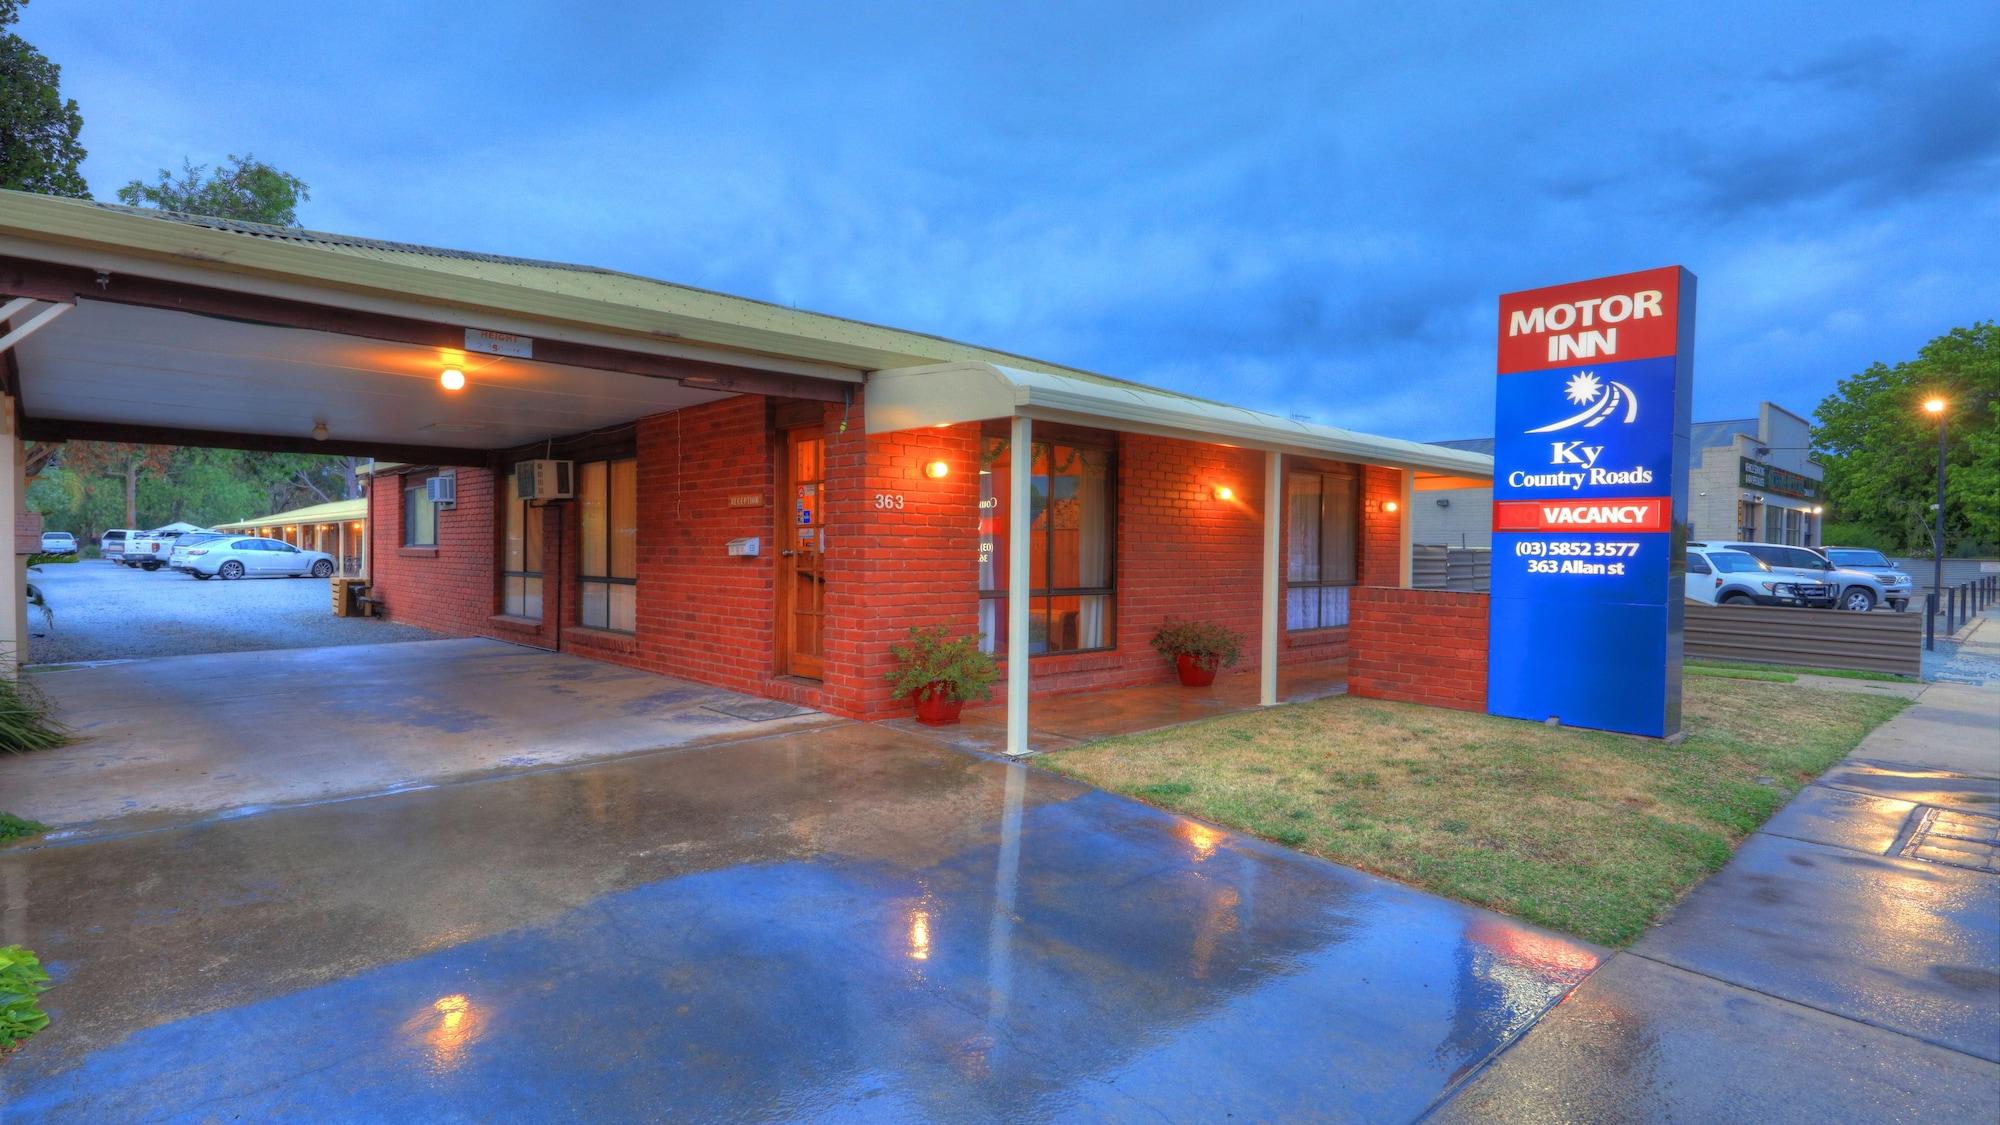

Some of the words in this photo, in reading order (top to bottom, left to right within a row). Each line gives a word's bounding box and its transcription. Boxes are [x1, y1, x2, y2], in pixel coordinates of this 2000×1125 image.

[1508, 289, 1663, 337] MOTOR
[1547, 328, 1617, 362] INN
[1550, 441, 1604, 469] Ky
[1508, 470, 1585, 490] Country
[1588, 466, 1653, 486] Roads
[874, 494, 905, 510] 363
[1543, 506, 1648, 524] VACANCY
[1515, 541, 1547, 557] (03)
[1549, 542, 1591, 556] 5852
[1593, 542, 1640, 557] 3577
[1527, 560, 1559, 573] 363
[1560, 560, 1605, 575] Allan
[1607, 562, 1625, 575] st
